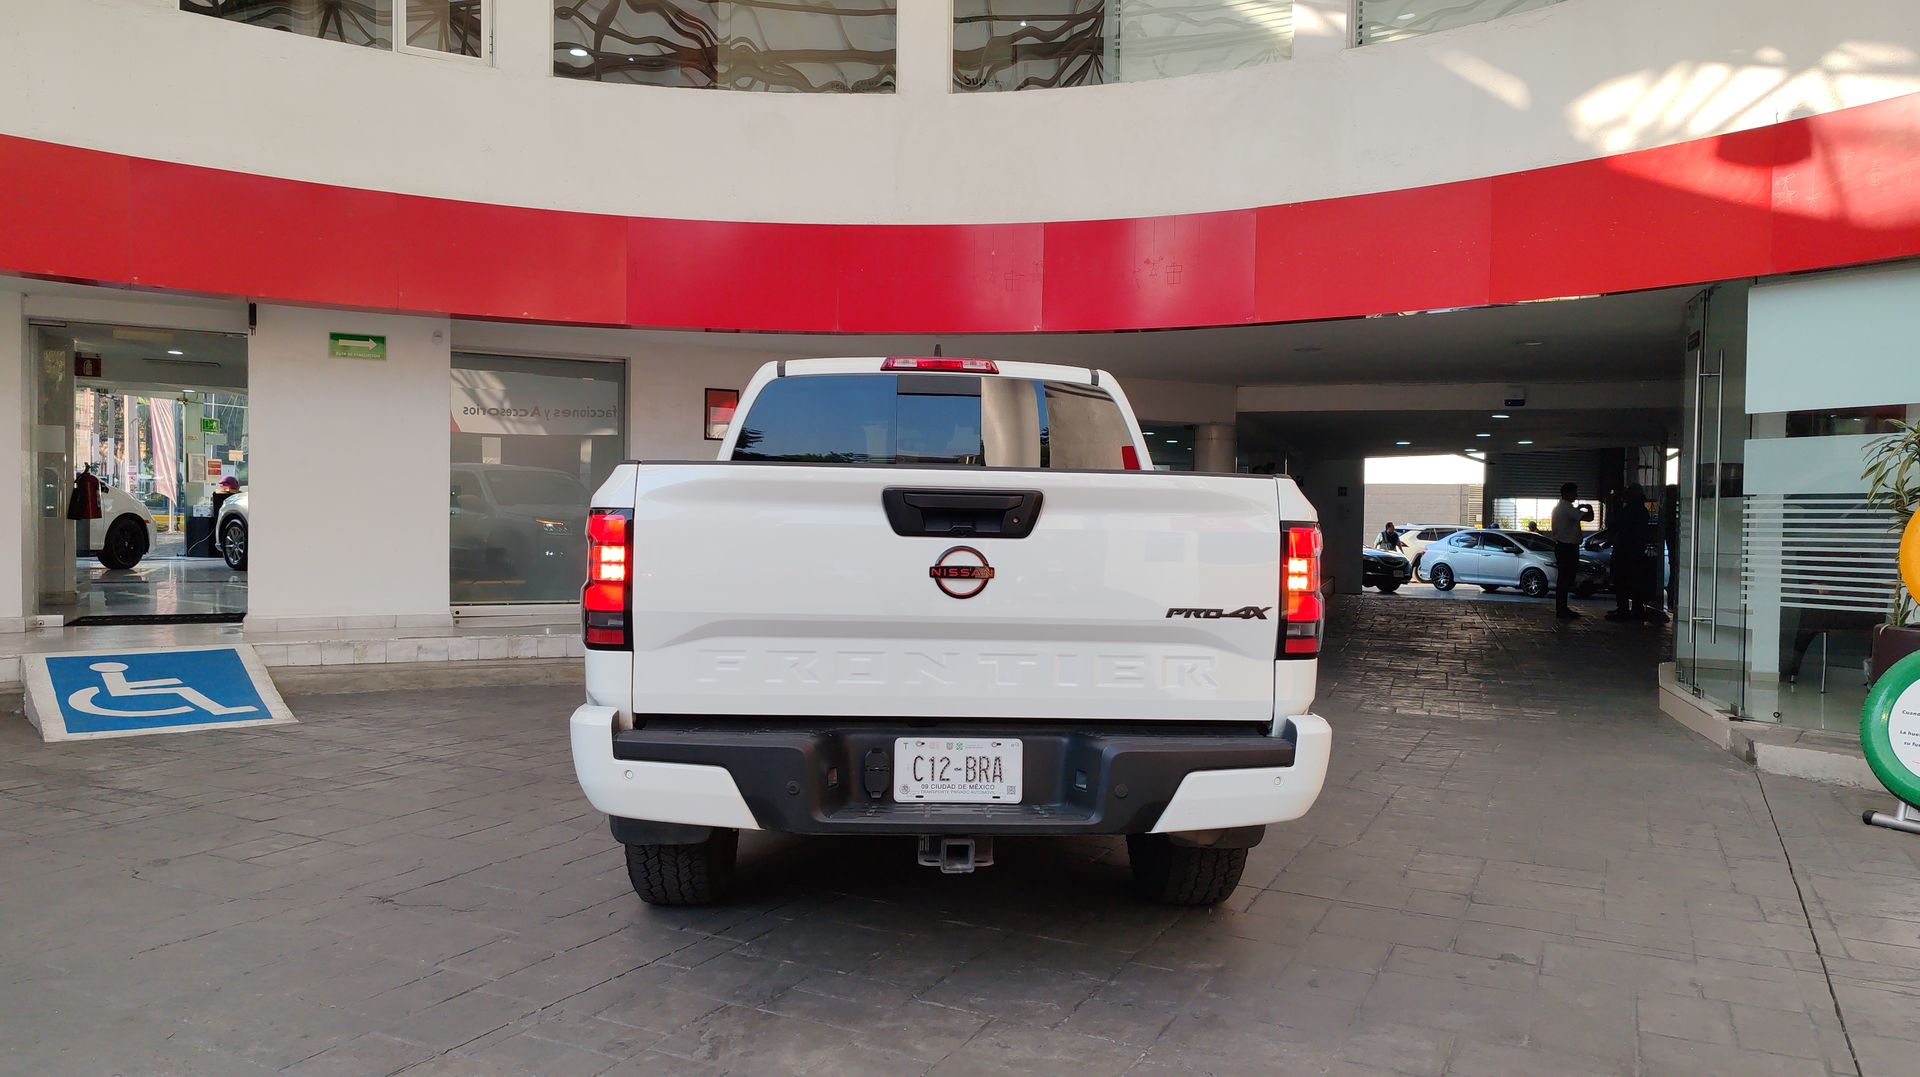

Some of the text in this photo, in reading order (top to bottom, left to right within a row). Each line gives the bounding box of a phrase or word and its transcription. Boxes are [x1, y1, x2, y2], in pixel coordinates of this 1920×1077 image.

[930, 567, 994, 578] NISSAN
[1165, 606, 1273, 620] PRO-4X
[696, 648, 1218, 689] FRONTIER
[912, 755, 1003, 783] C12-BRA
